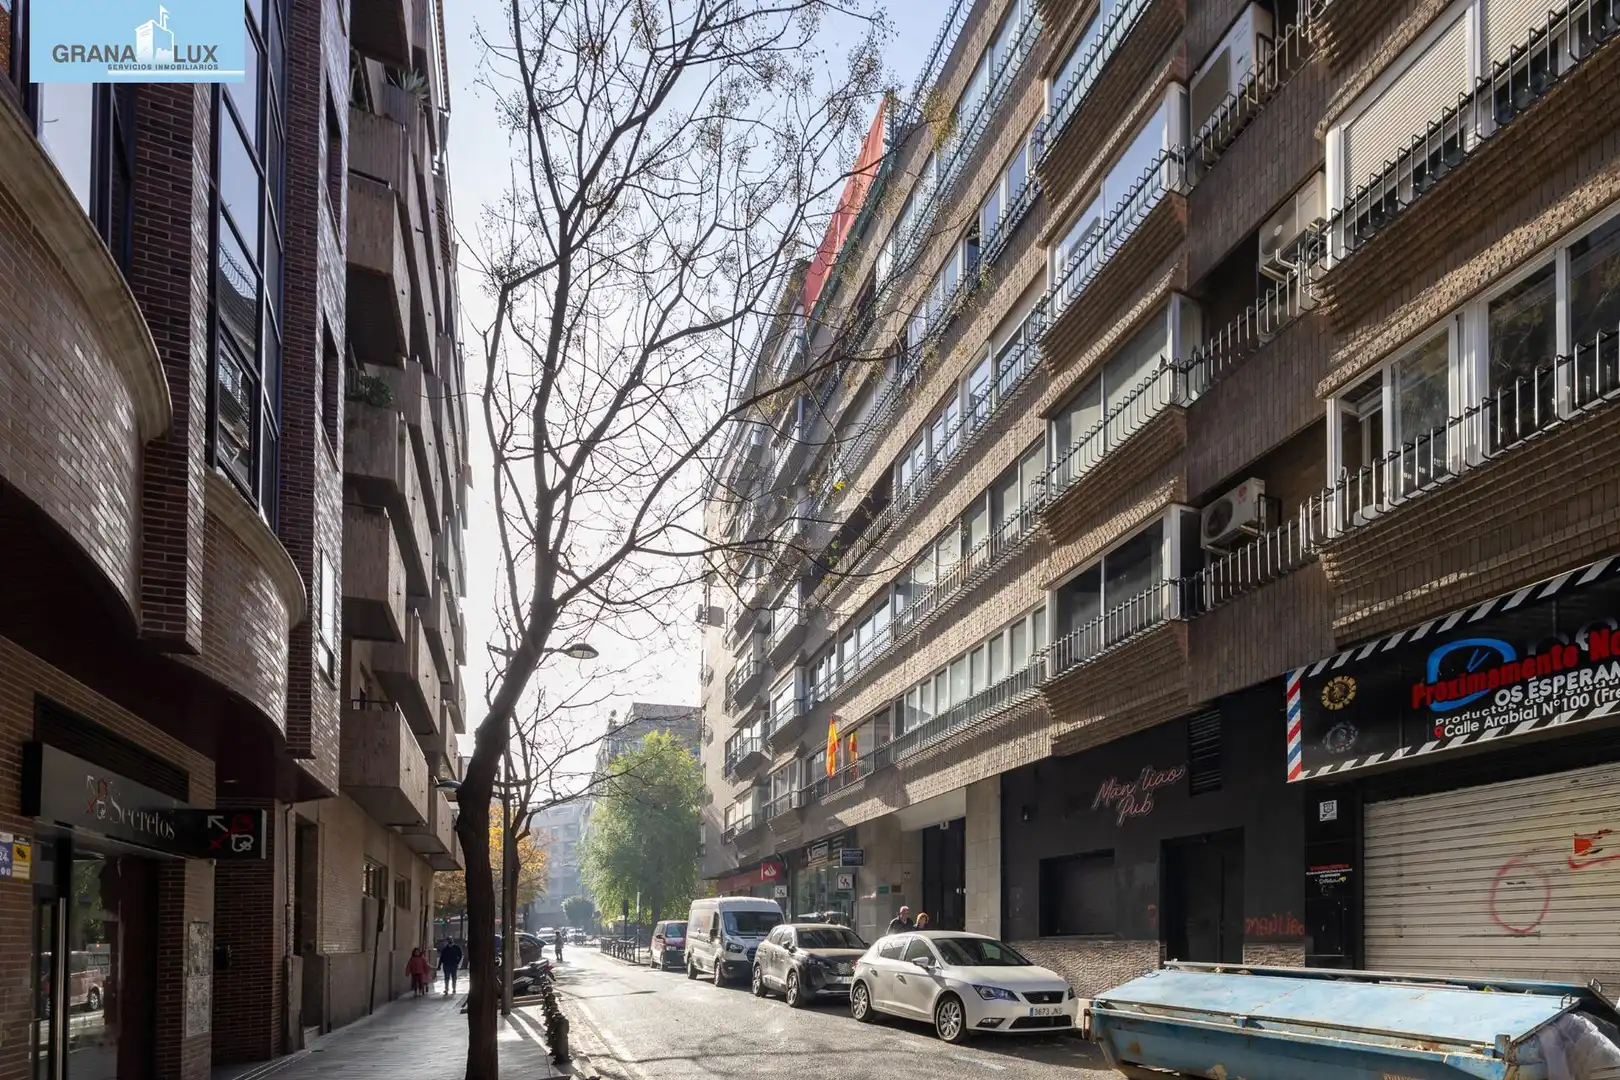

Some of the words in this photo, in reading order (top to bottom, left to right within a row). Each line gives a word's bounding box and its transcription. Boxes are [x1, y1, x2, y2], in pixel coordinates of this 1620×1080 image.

[1494, 684, 1523, 707] OS
[1444, 720, 1480, 737] Calle
[1483, 704, 1538, 729] Arabial
[1090, 776, 1137, 810] Man
[1116, 793, 1154, 826] Pub
[110, 796, 176, 840] Secretos
